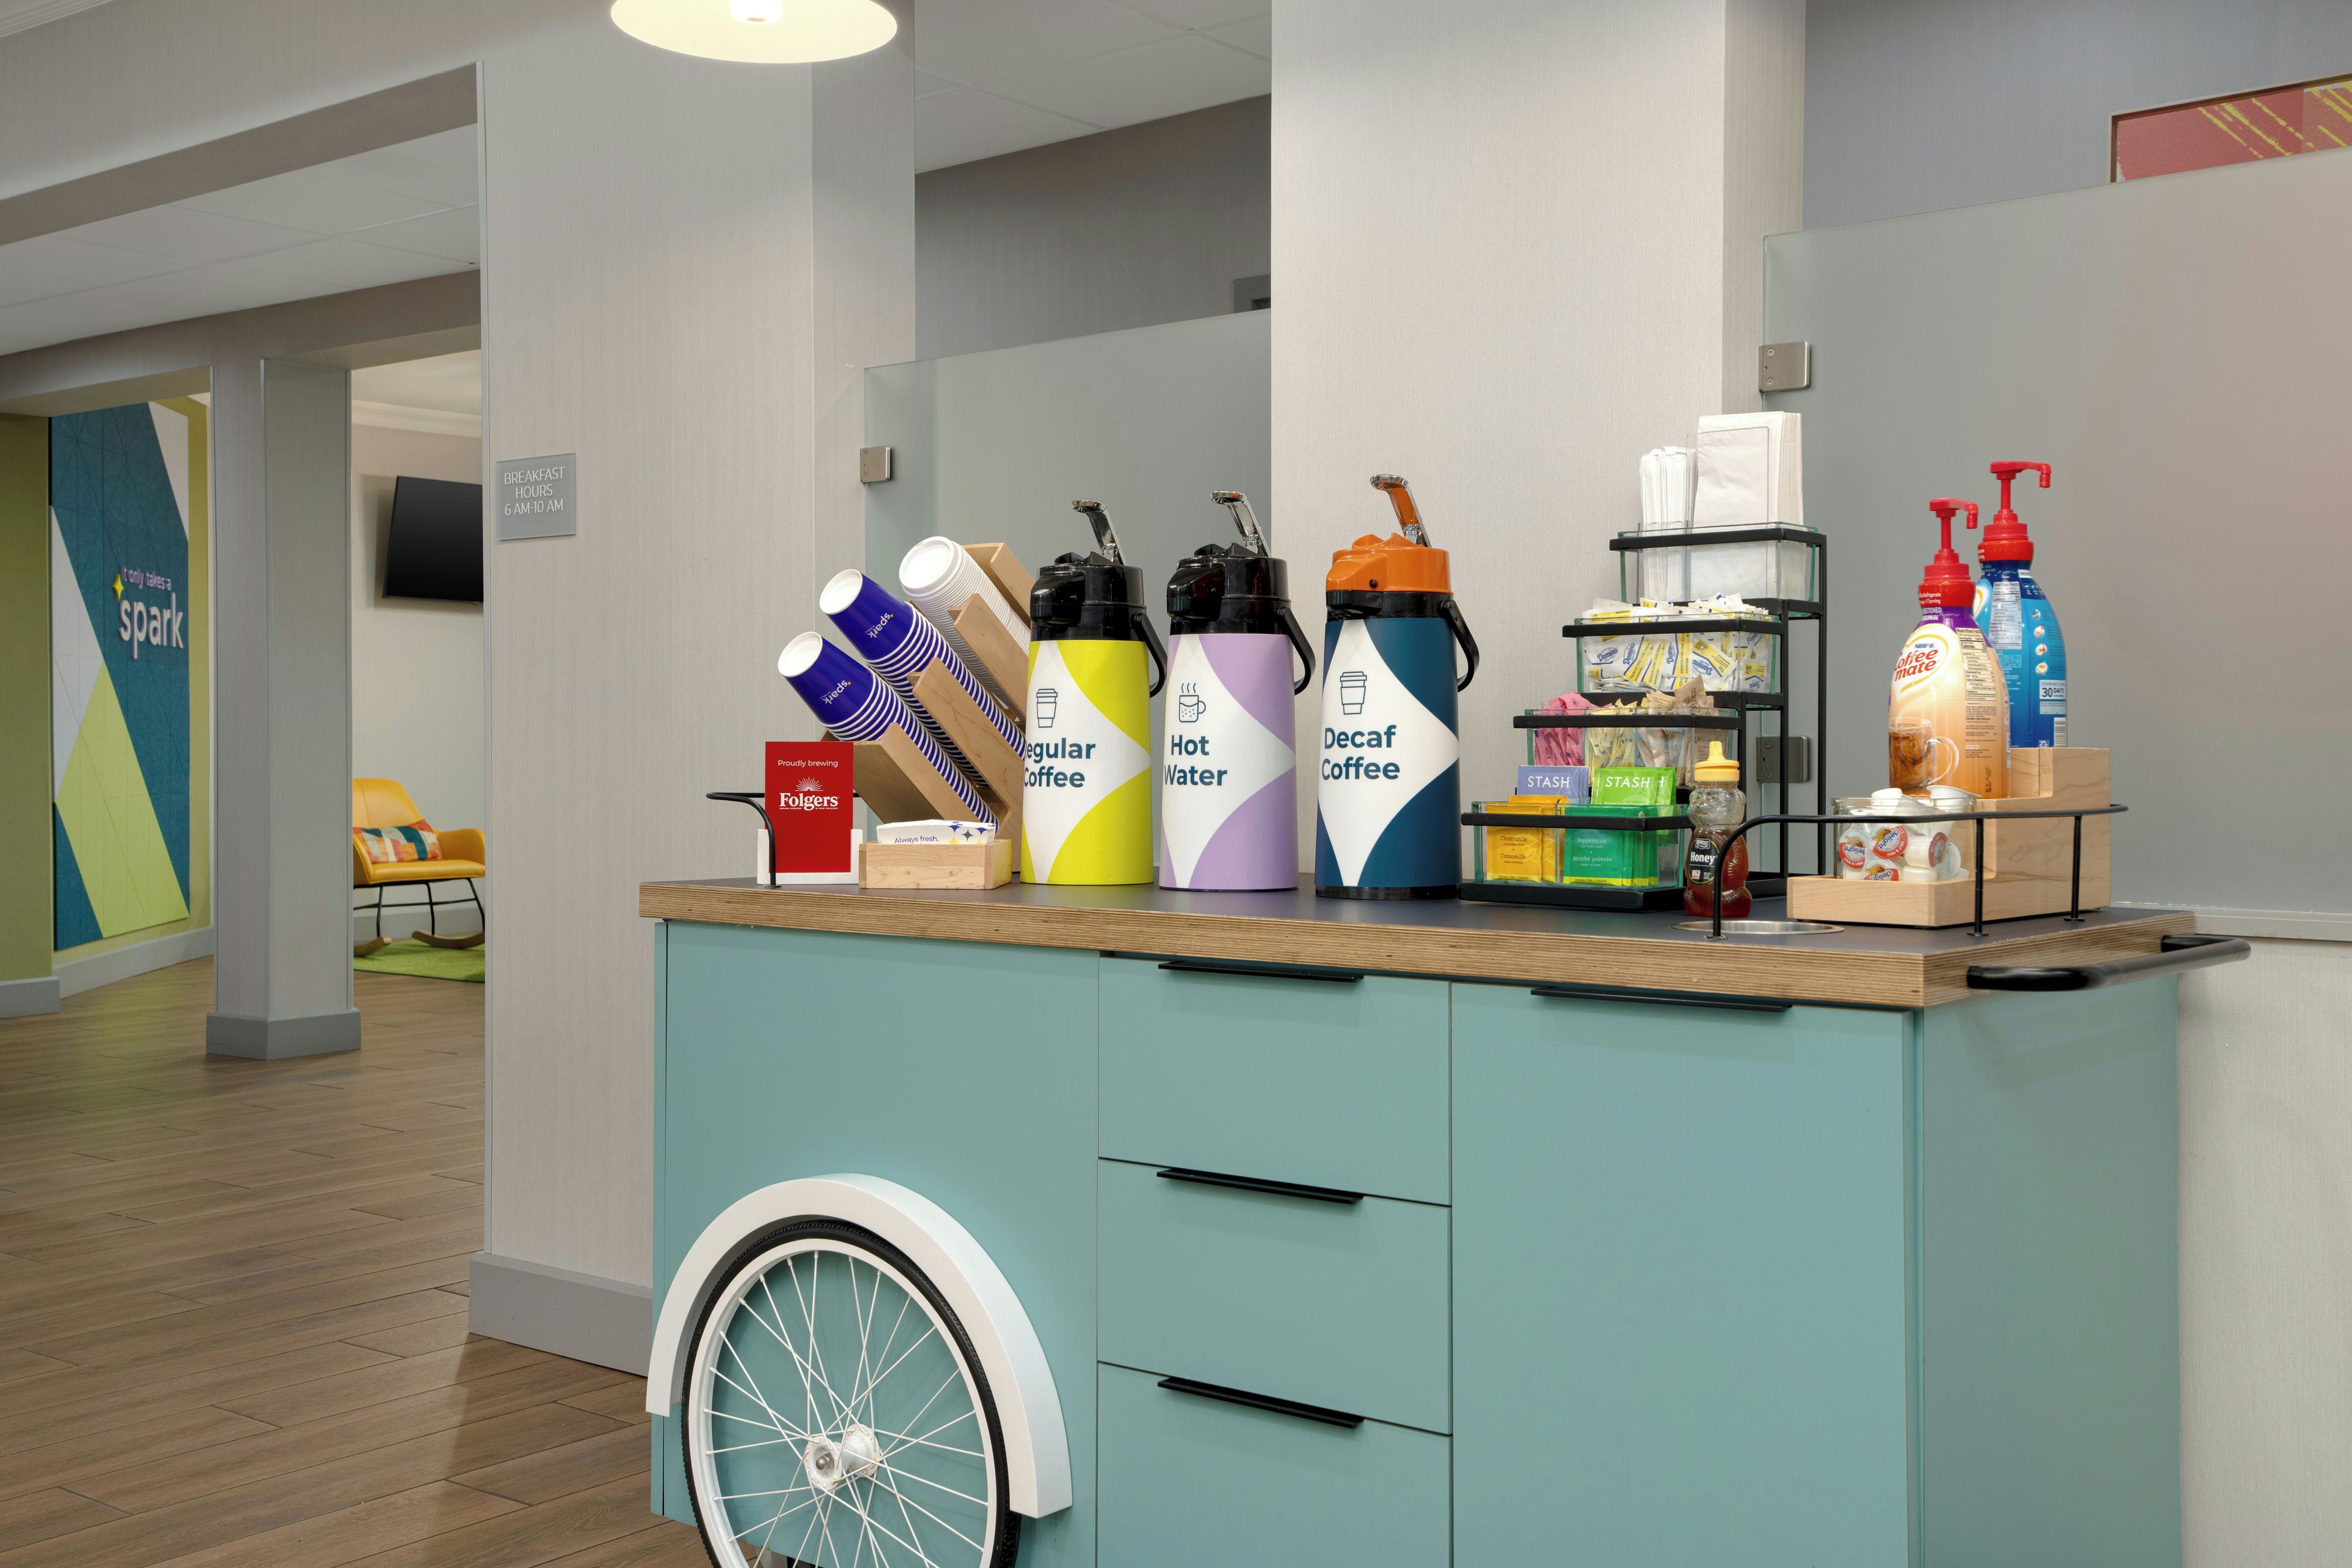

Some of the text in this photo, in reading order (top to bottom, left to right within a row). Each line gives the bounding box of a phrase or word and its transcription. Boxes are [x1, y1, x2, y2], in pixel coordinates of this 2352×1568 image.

[504, 467, 565, 484] BREAKFAST
[516, 484, 553, 499] HOURS
[505, 503, 511, 515] 6
[546, 499, 563, 512] AM
[127, 568, 144, 589] only
[146, 570, 165, 590] takes
[165, 578, 172, 590] a
[118, 592, 184, 659] spark
[867, 612, 891, 638] spark
[1597, 648, 1618, 662] Domino
[1623, 643, 1635, 665] Domino
[1894, 650, 1939, 671] offee
[1692, 660, 1713, 676] Domino
[1895, 660, 1937, 681] mate
[822, 680, 848, 704] spark
[2041, 687, 2053, 698] 30
[1170, 734, 1210, 756] Hot
[1324, 725, 1397, 750] Decaf
[1025, 737, 1096, 764] egular
[1024, 766, 1085, 788] Coffee
[1164, 764, 1227, 786] Water
[1321, 756, 1400, 781] Coffee
[1528, 776, 1570, 788] STASH
[1605, 777, 1651, 788] STASH
[779, 793, 839, 811] Folgers
[1878, 829, 1899, 850] delight
[1691, 851, 1715, 865] Honey
